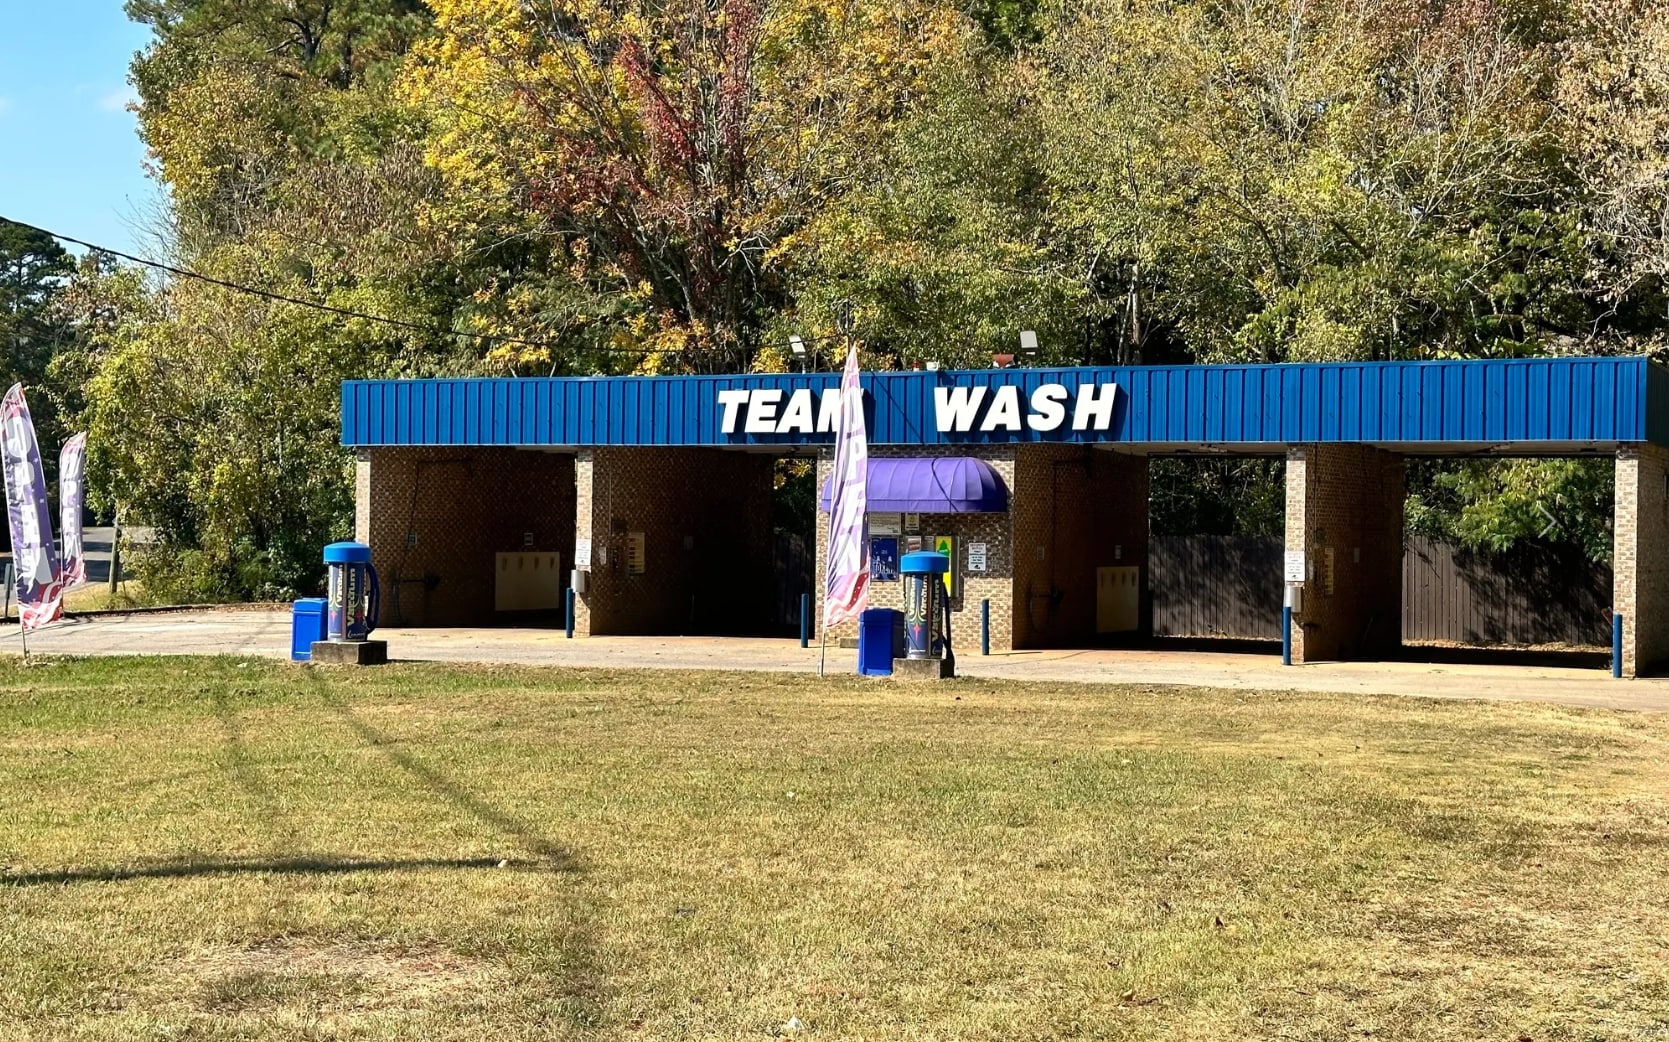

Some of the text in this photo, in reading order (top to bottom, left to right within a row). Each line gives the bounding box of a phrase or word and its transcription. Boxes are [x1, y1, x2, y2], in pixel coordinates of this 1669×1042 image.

[934, 383, 1118, 432] WASH
[347, 568, 355, 626] Vacuum
[931, 579, 939, 642] Vacuum
